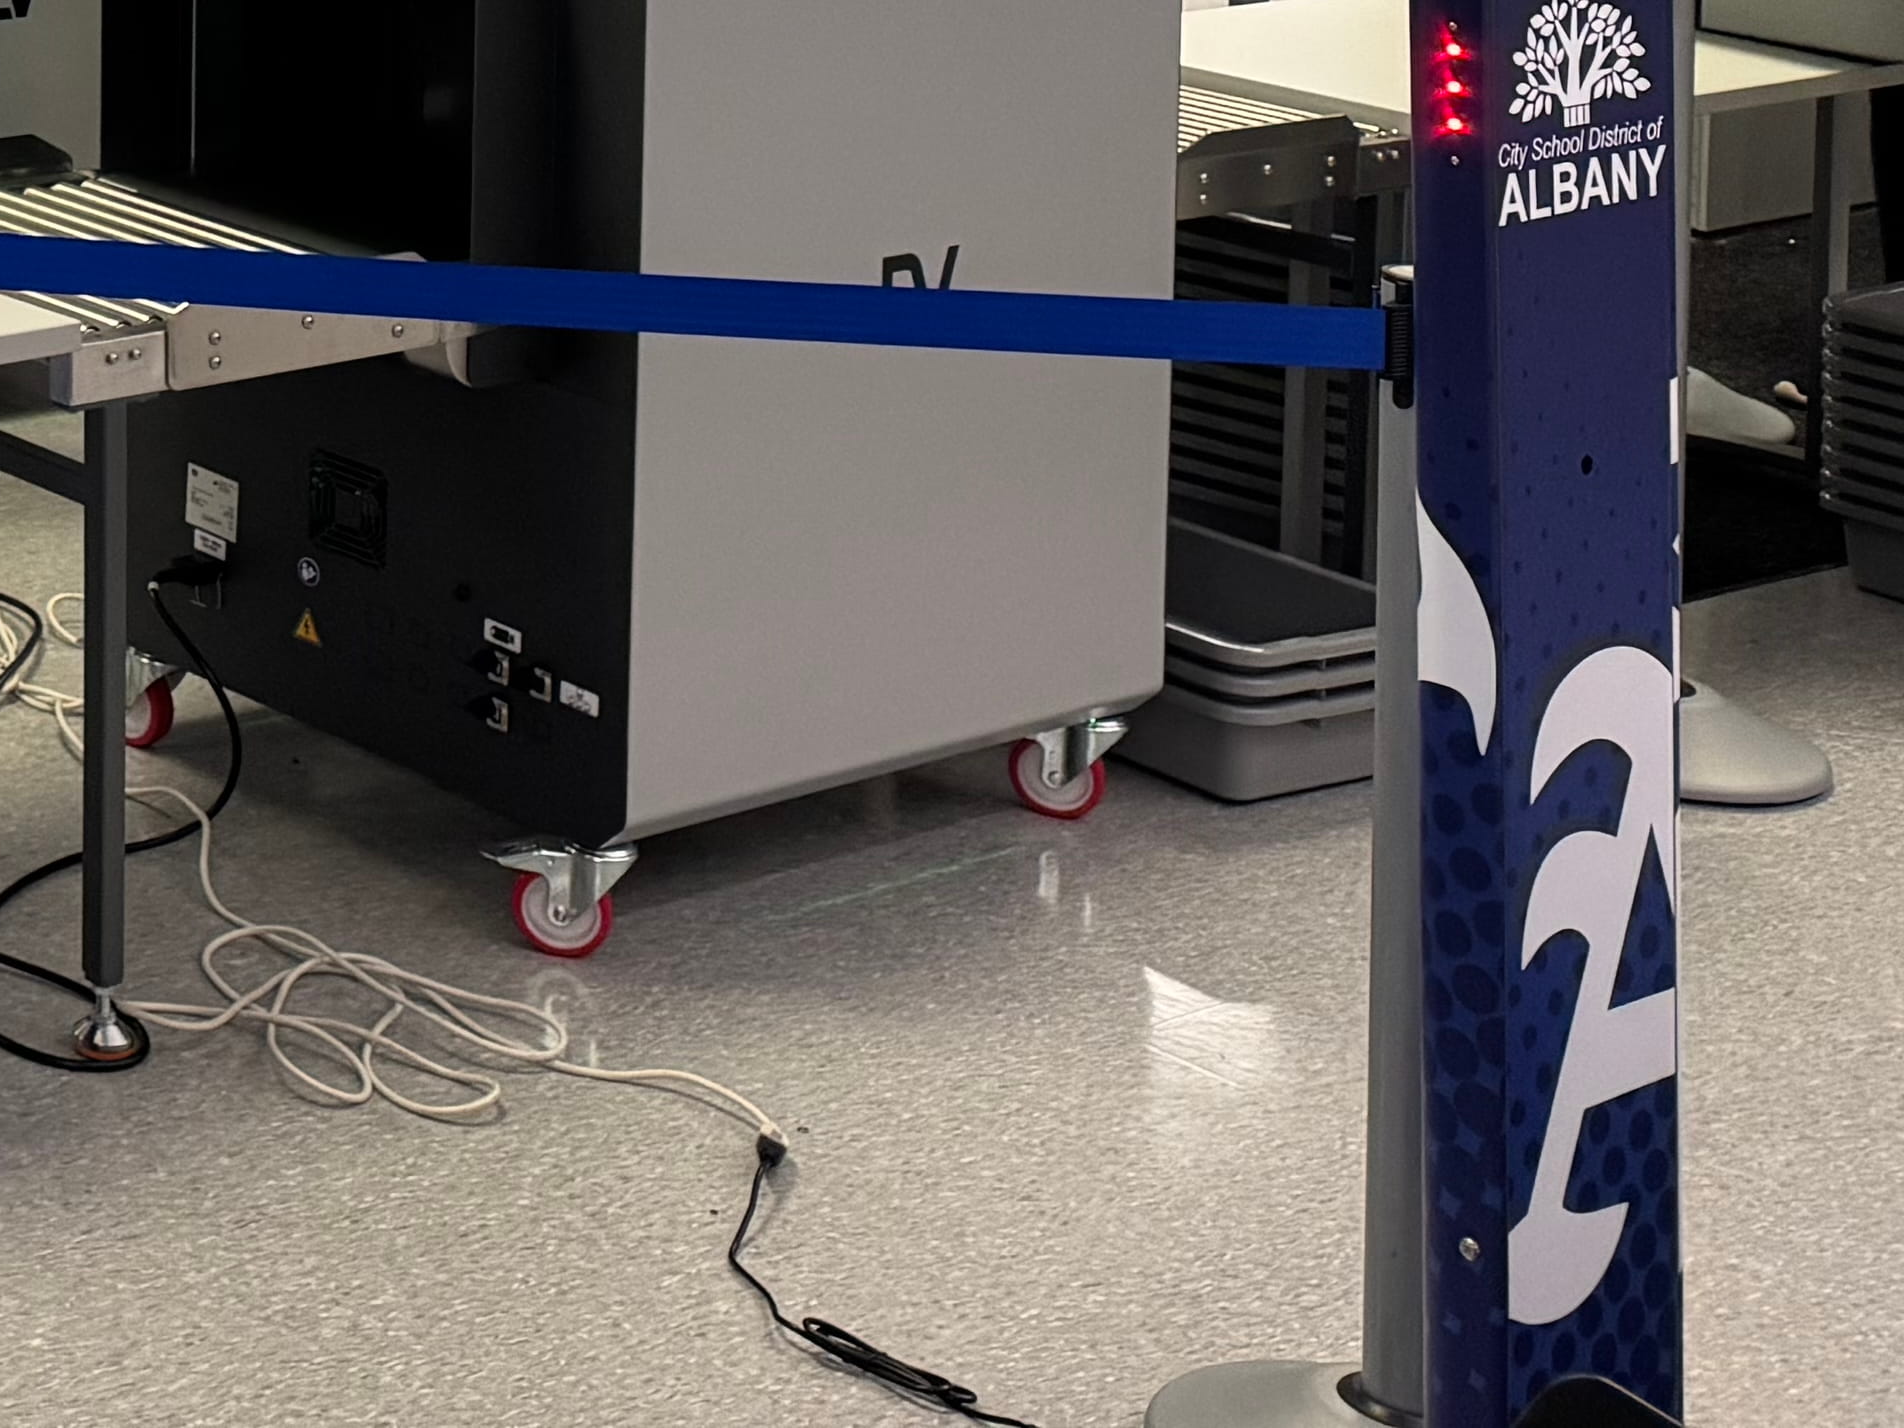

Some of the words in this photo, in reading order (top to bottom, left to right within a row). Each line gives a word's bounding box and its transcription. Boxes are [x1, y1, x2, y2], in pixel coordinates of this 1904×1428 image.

[1498, 142, 1529, 170] City
[1531, 128, 1585, 161] School
[1588, 119, 1643, 151] District
[1646, 115, 1665, 140] of
[1498, 144, 1667, 227] ALBANY
